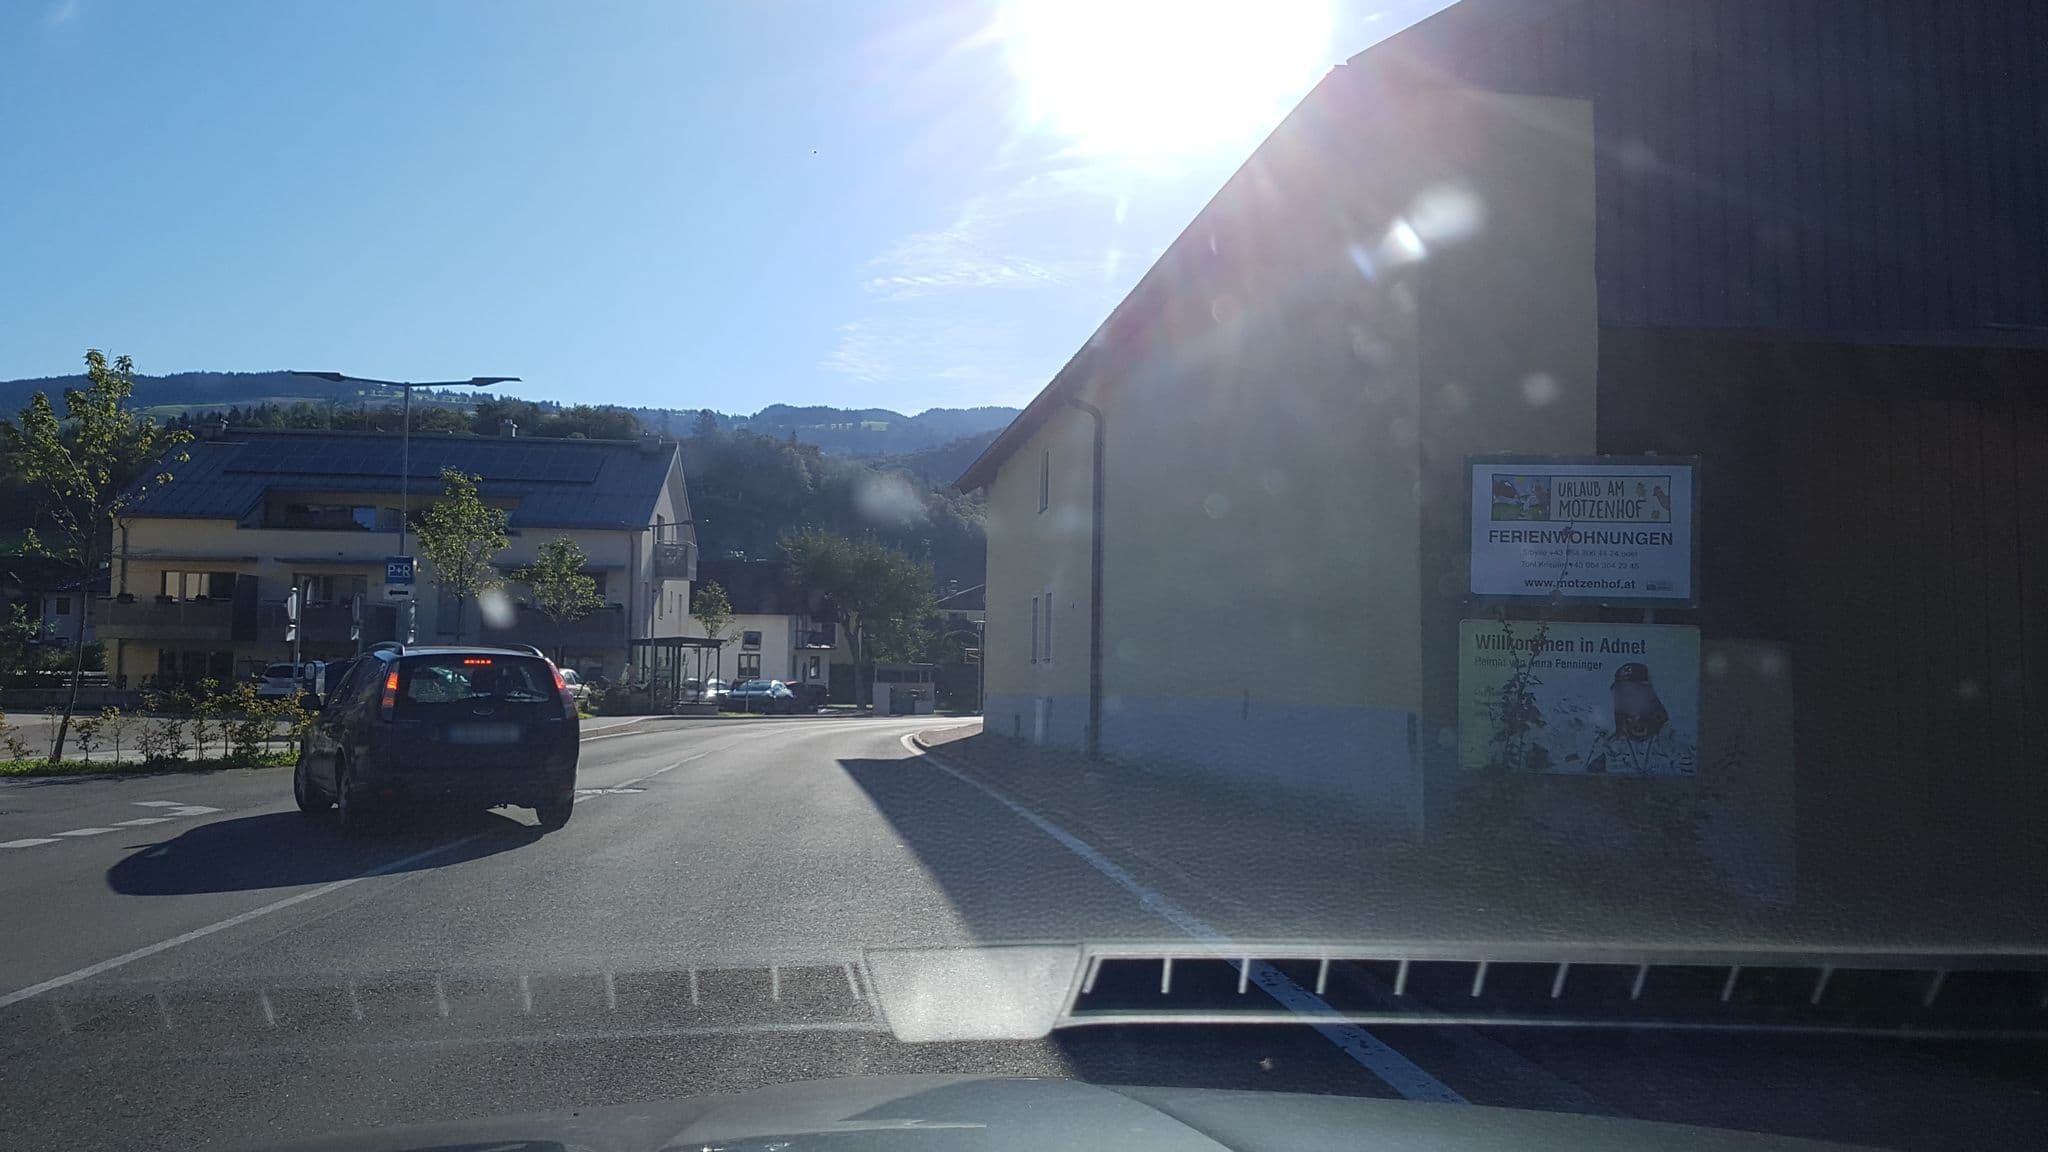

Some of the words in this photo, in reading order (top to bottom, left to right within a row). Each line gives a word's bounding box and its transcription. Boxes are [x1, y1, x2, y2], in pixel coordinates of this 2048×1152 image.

[1558, 481, 1601, 497] URLAUB
[1608, 480, 1625, 496] AM
[1558, 499, 1648, 519] MOTZENHOF
[1488, 530, 1673, 545] FERIENWOHNUNGEN
[388, 564, 411, 578] P+R
[1524, 579, 1636, 590] www.motzenhof.at
[1580, 637, 1594, 652] in
[1600, 637, 1646, 654] Adnet
[1555, 659, 1602, 671] Fenninger
